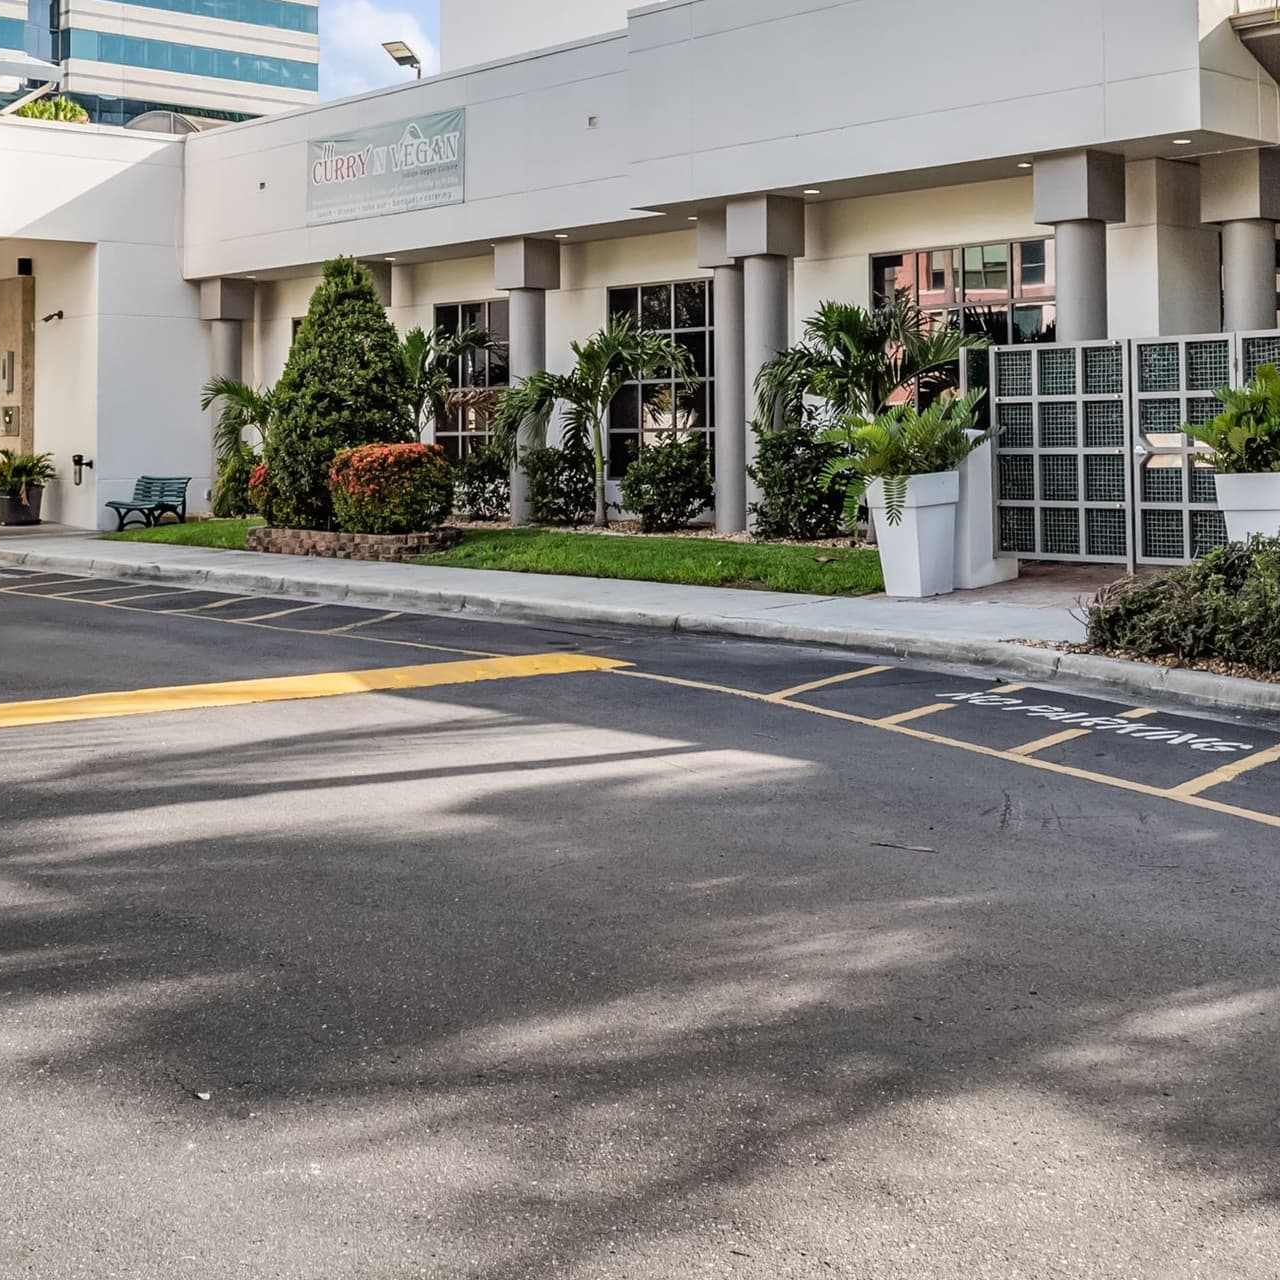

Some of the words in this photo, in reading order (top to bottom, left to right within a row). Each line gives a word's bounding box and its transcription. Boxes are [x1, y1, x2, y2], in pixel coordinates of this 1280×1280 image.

[312, 144, 372, 185] CURRY
[389, 131, 459, 170] VEGAN
[934, 691, 1023, 707] NO
[1001, 704, 1254, 752] PARKING
